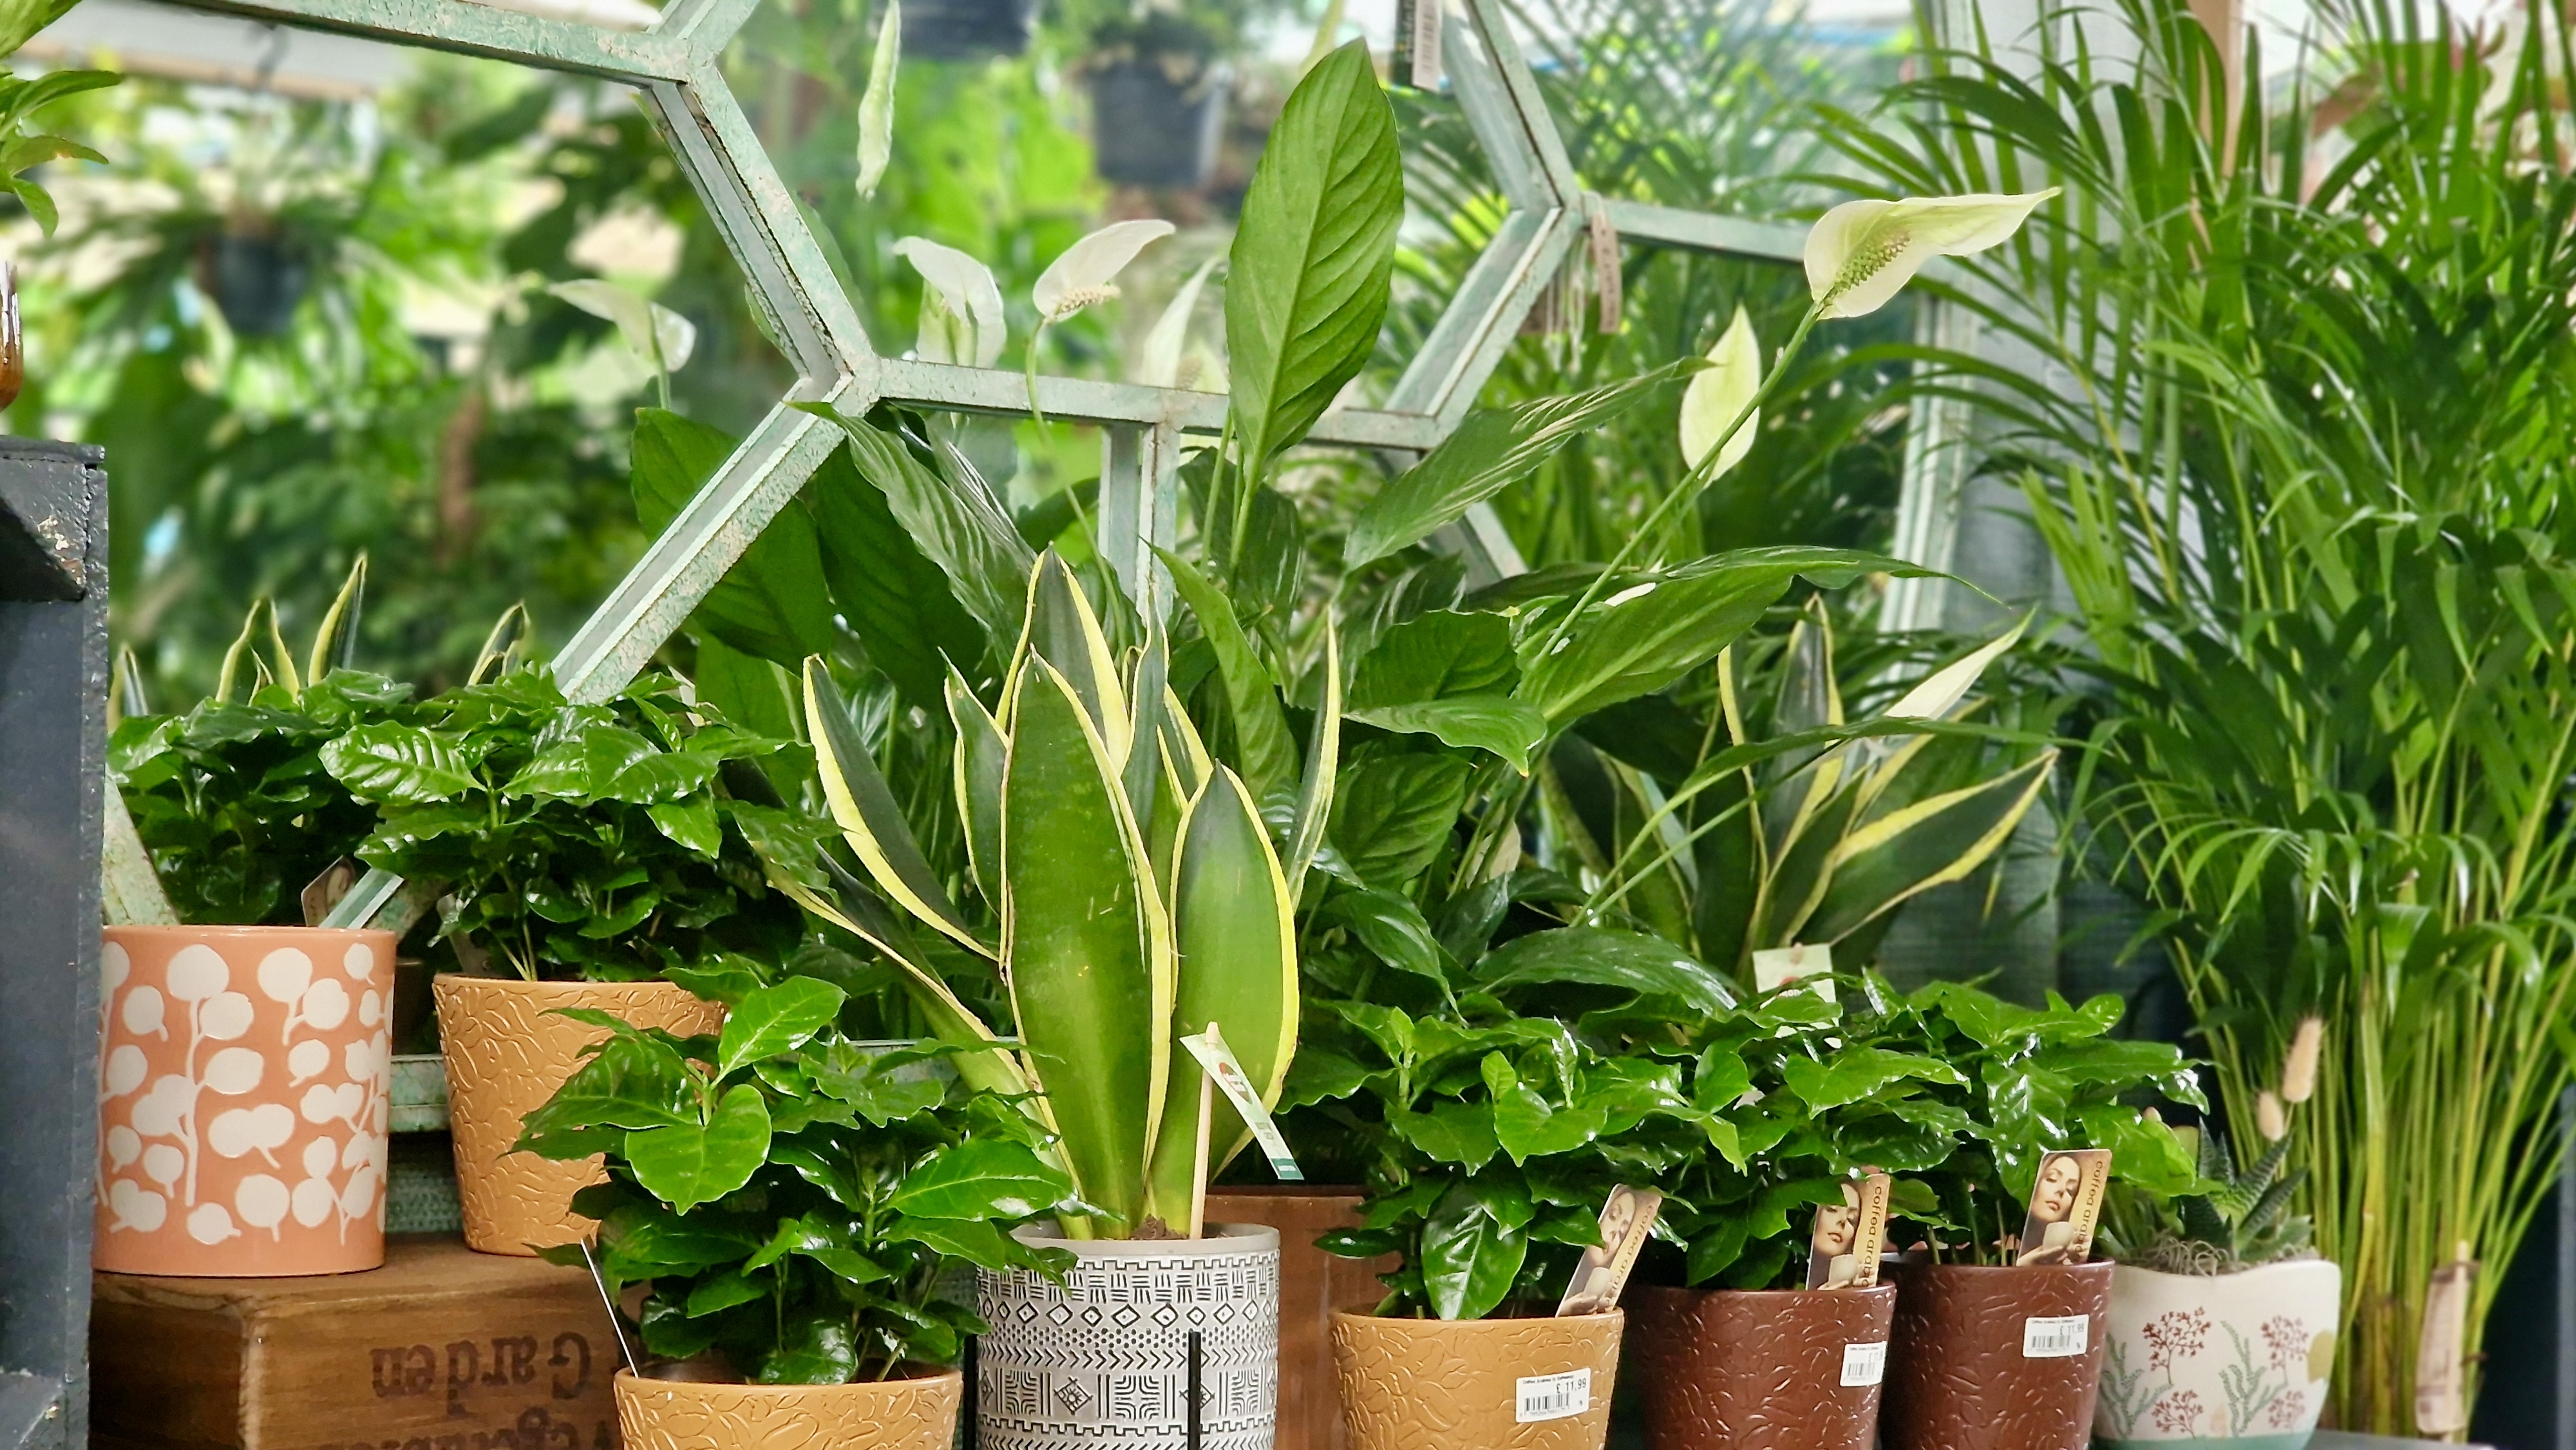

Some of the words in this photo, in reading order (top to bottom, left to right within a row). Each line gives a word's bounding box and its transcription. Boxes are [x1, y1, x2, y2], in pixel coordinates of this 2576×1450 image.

[2087, 1161, 2103, 1206] coffea
[1868, 1186, 1882, 1236] coffea
[368, 1331, 592, 1417] Garden
[1556, 1383, 1561, 1394] £
[1566, 1377, 1587, 1391] 11.99
